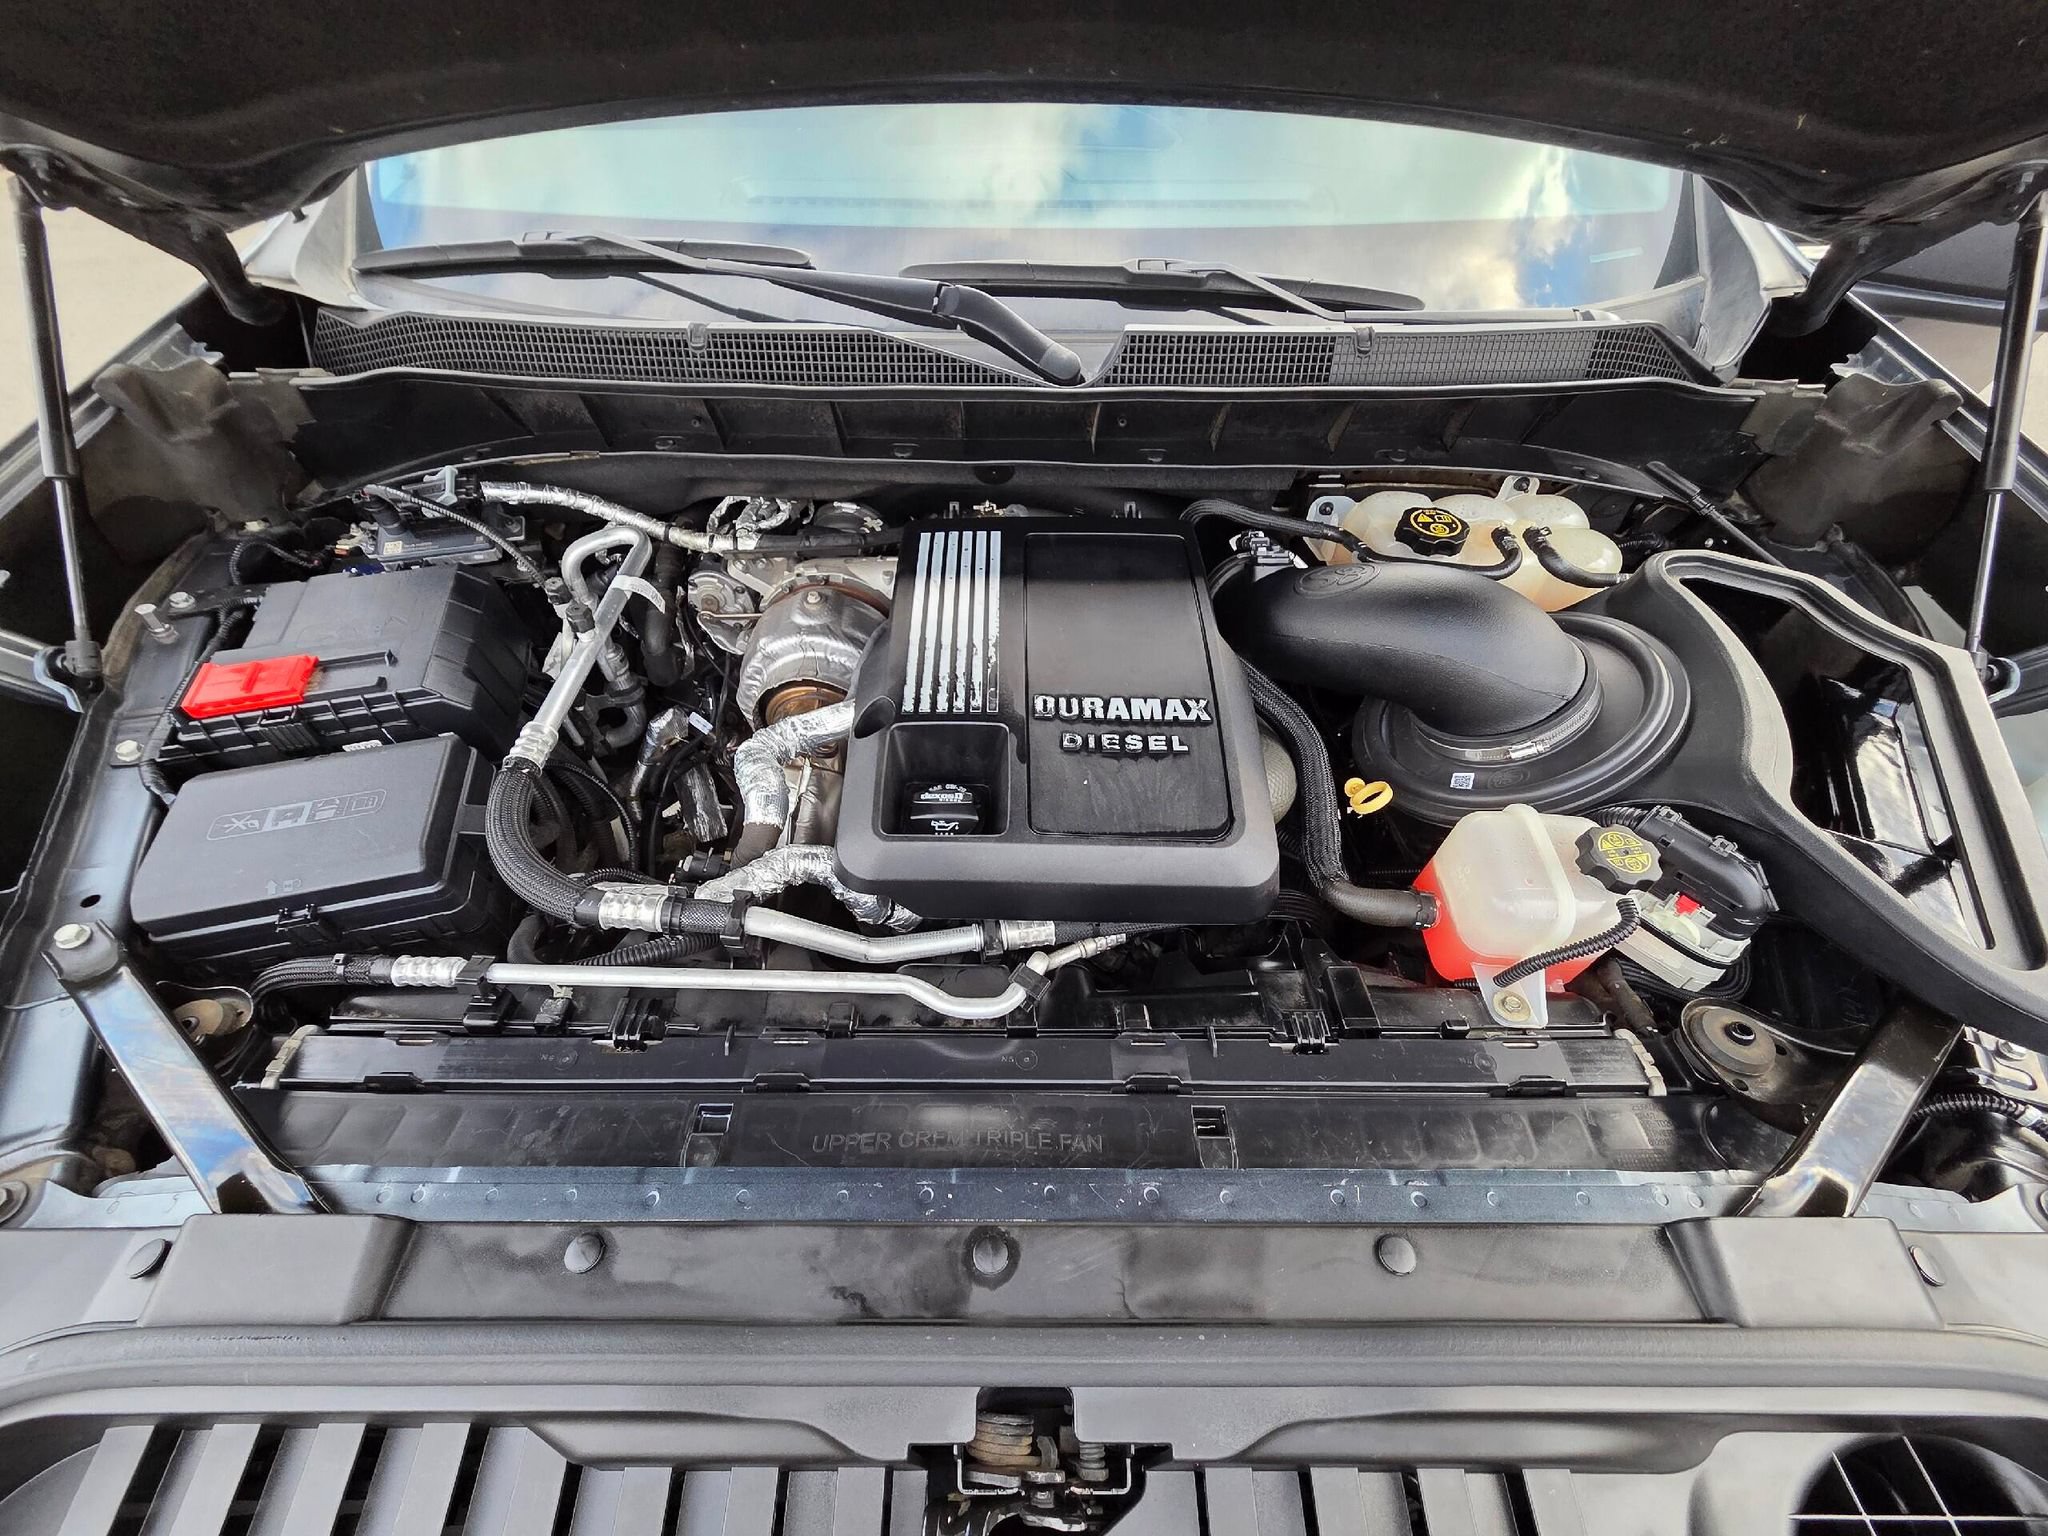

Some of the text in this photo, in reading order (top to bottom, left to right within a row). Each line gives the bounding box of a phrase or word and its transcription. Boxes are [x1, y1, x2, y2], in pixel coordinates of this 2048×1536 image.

[1033, 694, 1212, 722] DURAMAX
[1062, 732, 1189, 753] DIESEL
[812, 1131, 891, 1153] UPPER
[974, 1128, 1052, 1150] TRIPLE
[1058, 1133, 1103, 1153] FAN
